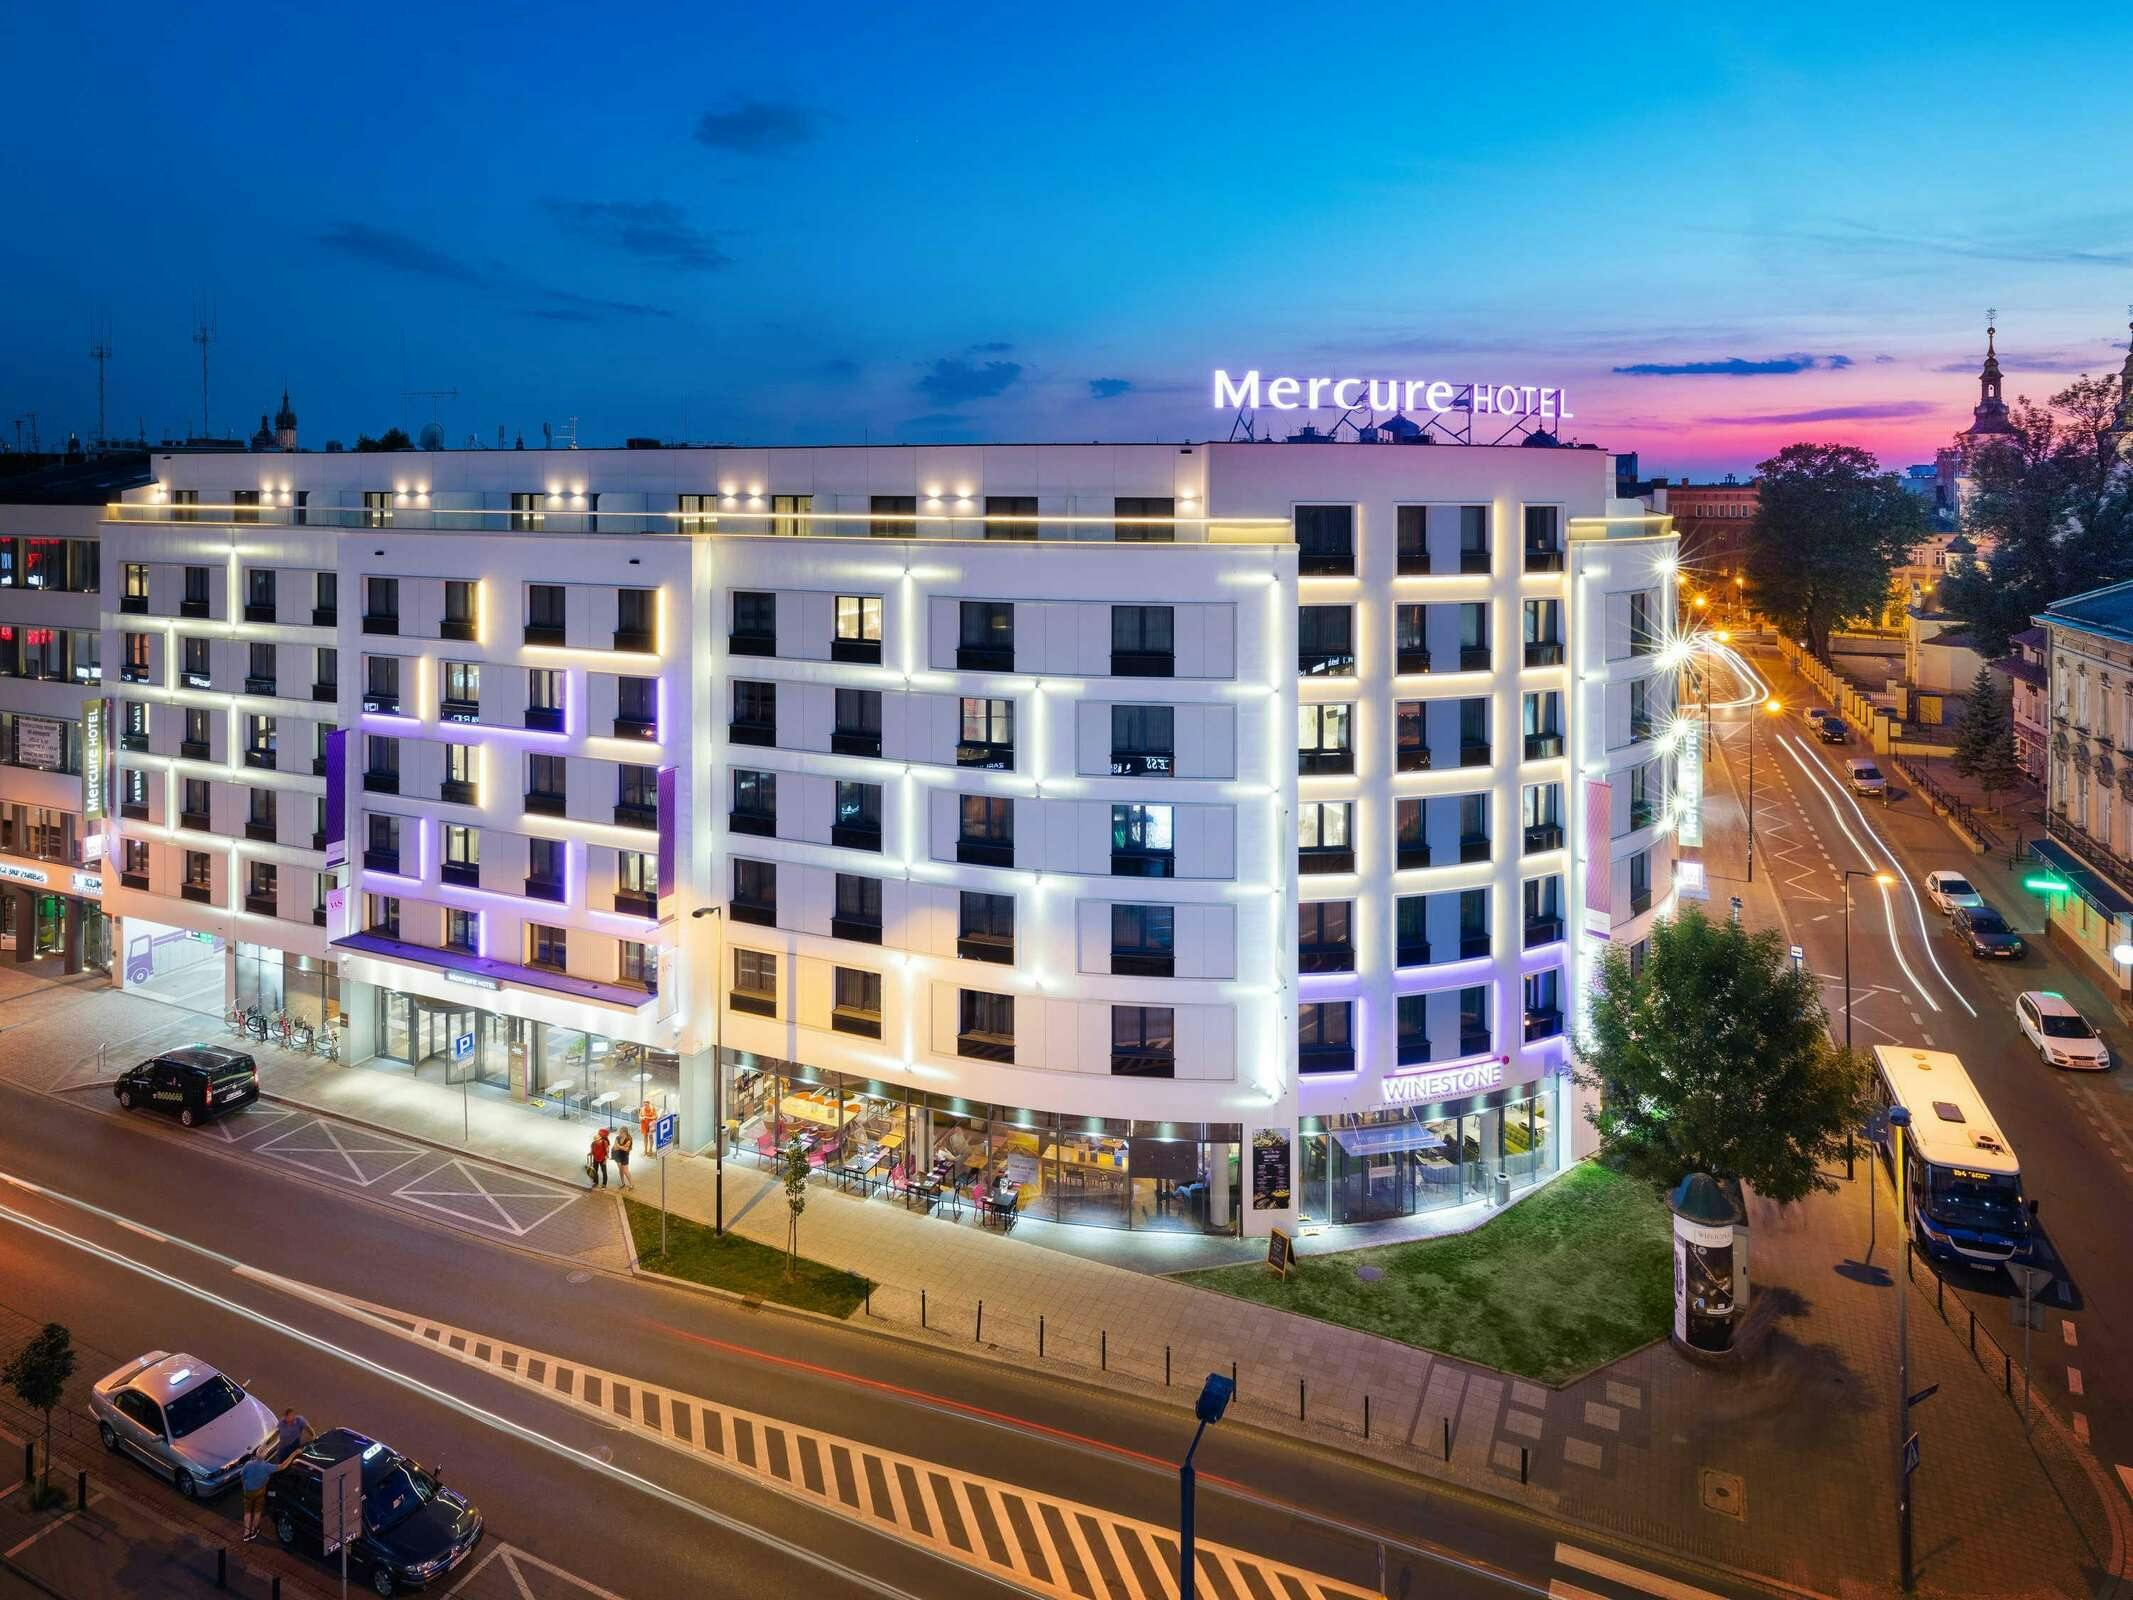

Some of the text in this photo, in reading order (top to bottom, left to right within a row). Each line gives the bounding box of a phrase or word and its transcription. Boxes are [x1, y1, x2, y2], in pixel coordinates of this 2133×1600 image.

[1214, 369, 1574, 418] Mercure HOTEL
[87, 708, 99, 812] Mercure HOTEL
[460, 1036, 470, 1054] P
[1385, 1065, 1502, 1100] WINESTONE
[660, 1118, 670, 1140] P
